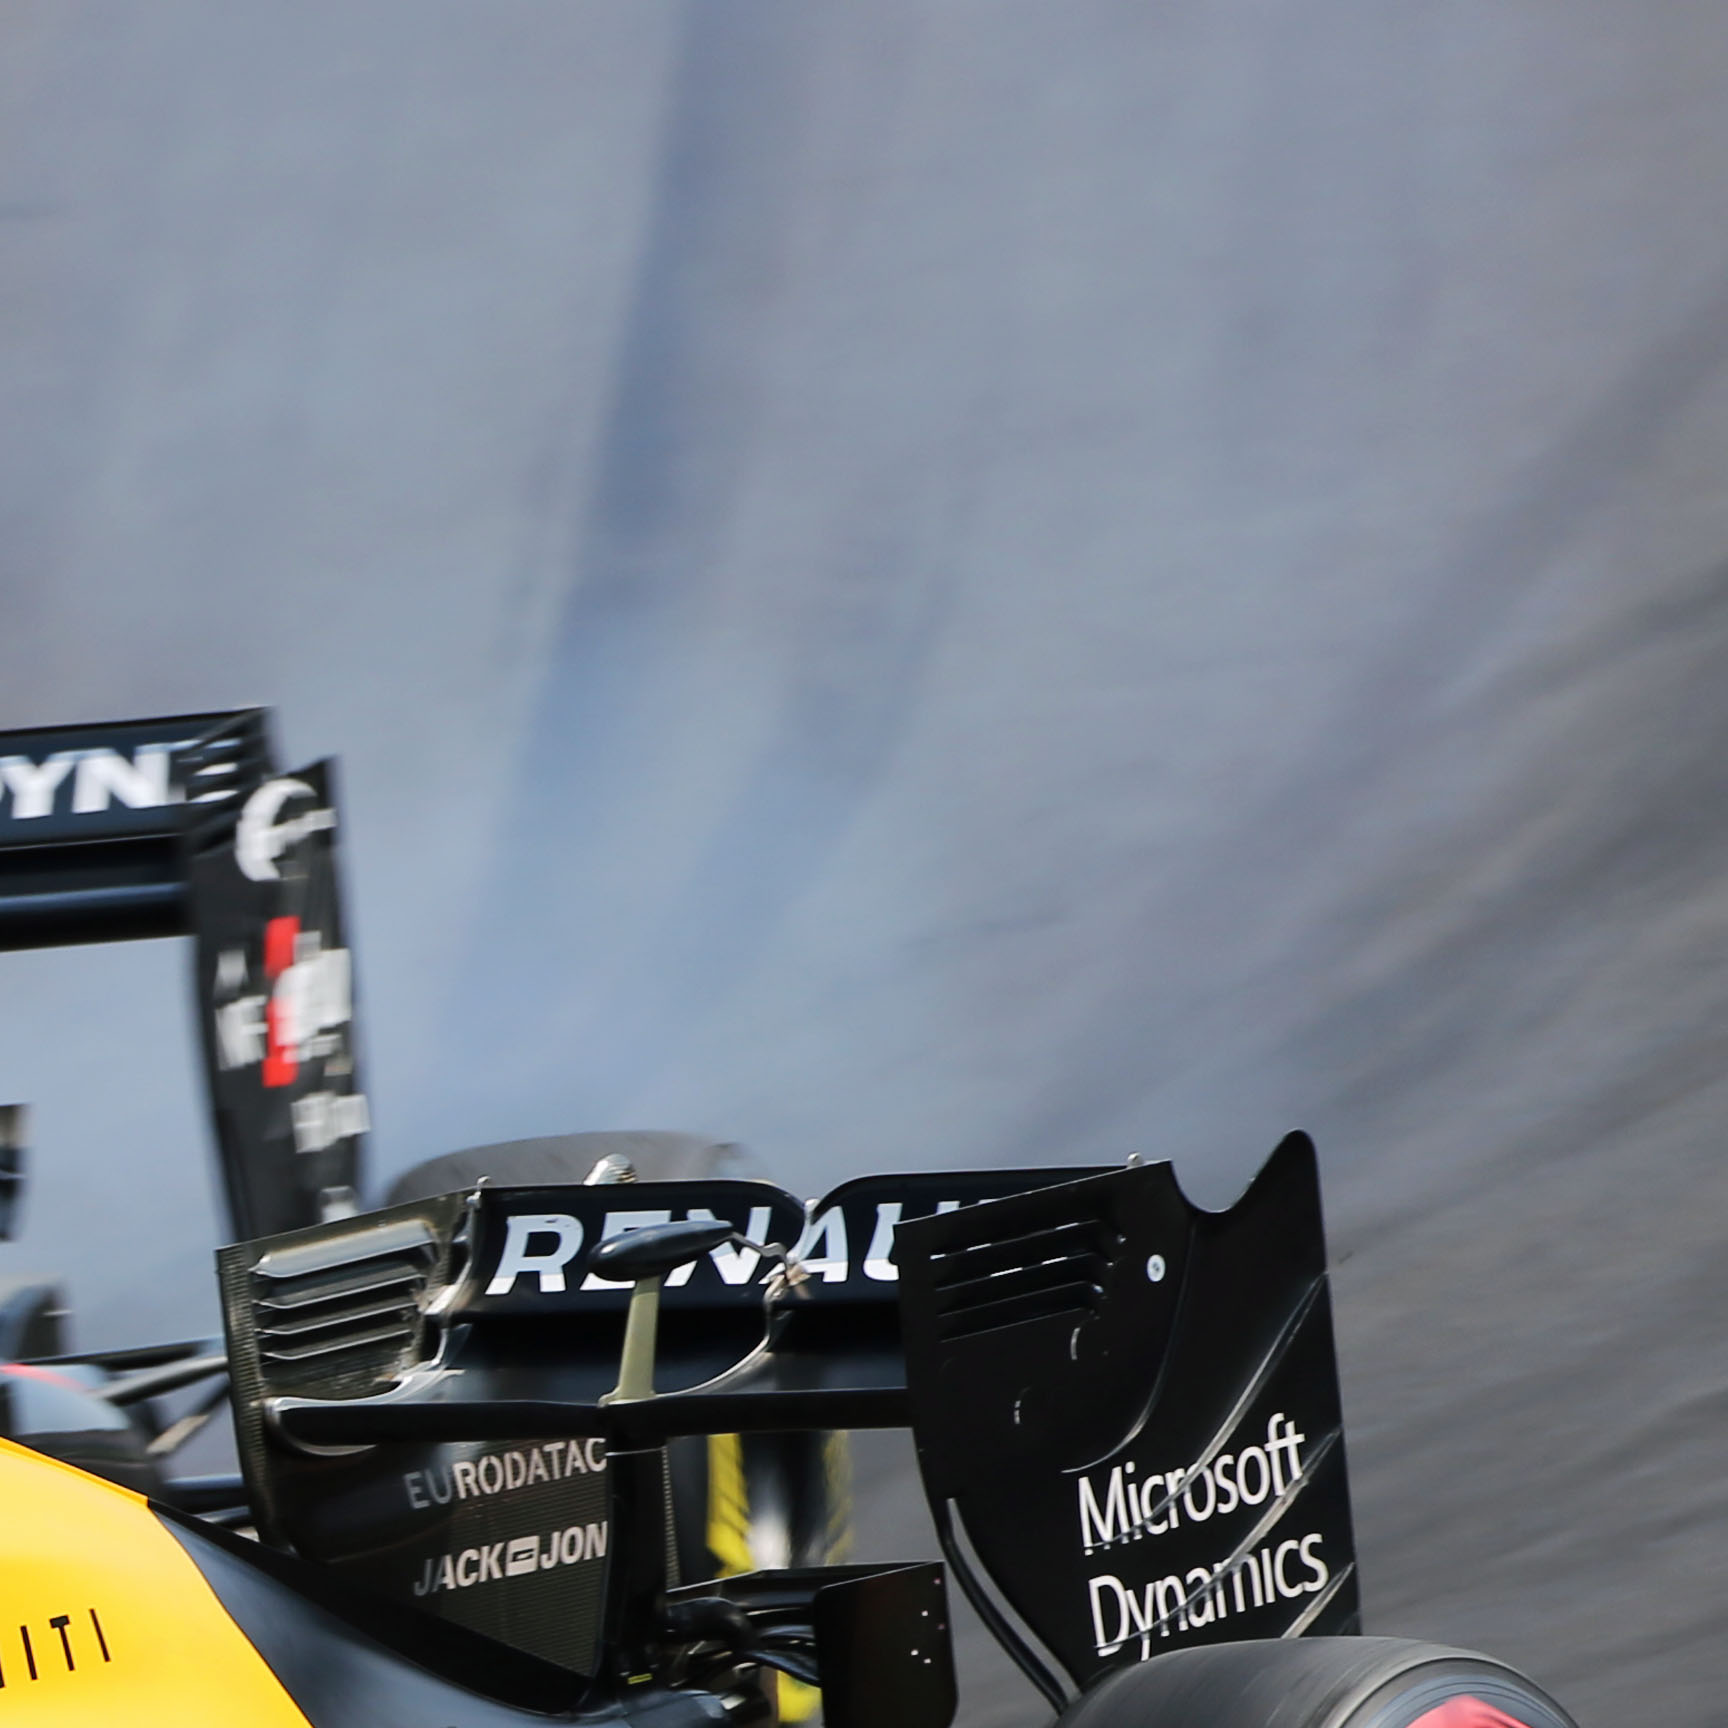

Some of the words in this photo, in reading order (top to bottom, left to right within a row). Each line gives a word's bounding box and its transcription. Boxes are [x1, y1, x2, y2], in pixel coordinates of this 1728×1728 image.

[403, 1438, 607, 1509] EURODATAC
[1077, 1412, 1306, 1555] Microsoft
[413, 1542, 505, 1596] JACK
[1088, 1533, 1329, 1661] Dynamics
